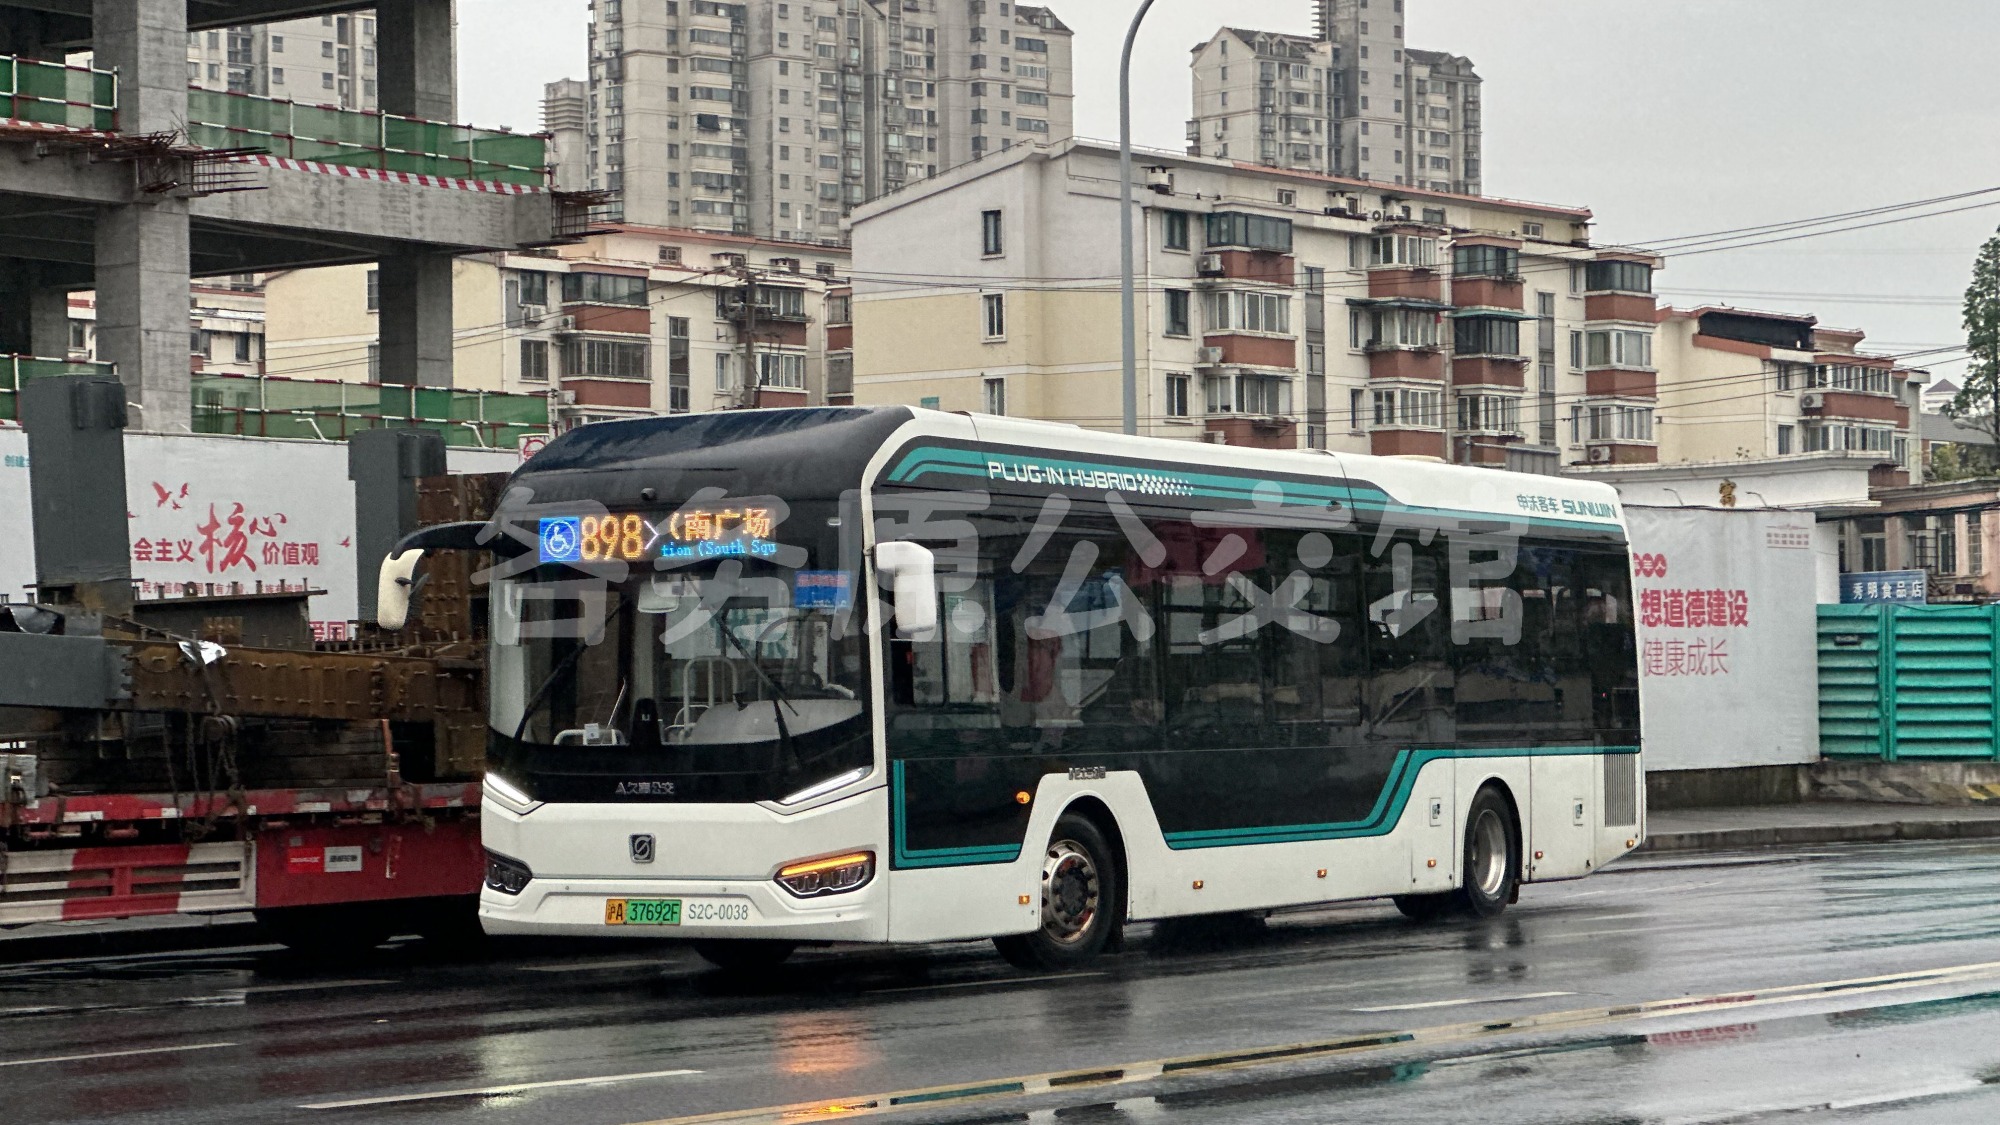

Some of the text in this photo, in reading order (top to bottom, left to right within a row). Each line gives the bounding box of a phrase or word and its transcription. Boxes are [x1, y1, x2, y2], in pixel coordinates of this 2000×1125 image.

[988, 461, 1137, 491] PLUG-IN HYBRID
[1516, 494, 1617, 518] 申沃客车 SUNWIN
[581, 515, 643, 560] 898
[661, 539, 777, 557] tion (South Squ
[1853, 580, 1923, 600] 秀明食品店
[1641, 587, 1748, 628] 想道德建设
[1642, 637, 1728, 677] 健康成长
[688, 903, 748, 920] S2C-0038
